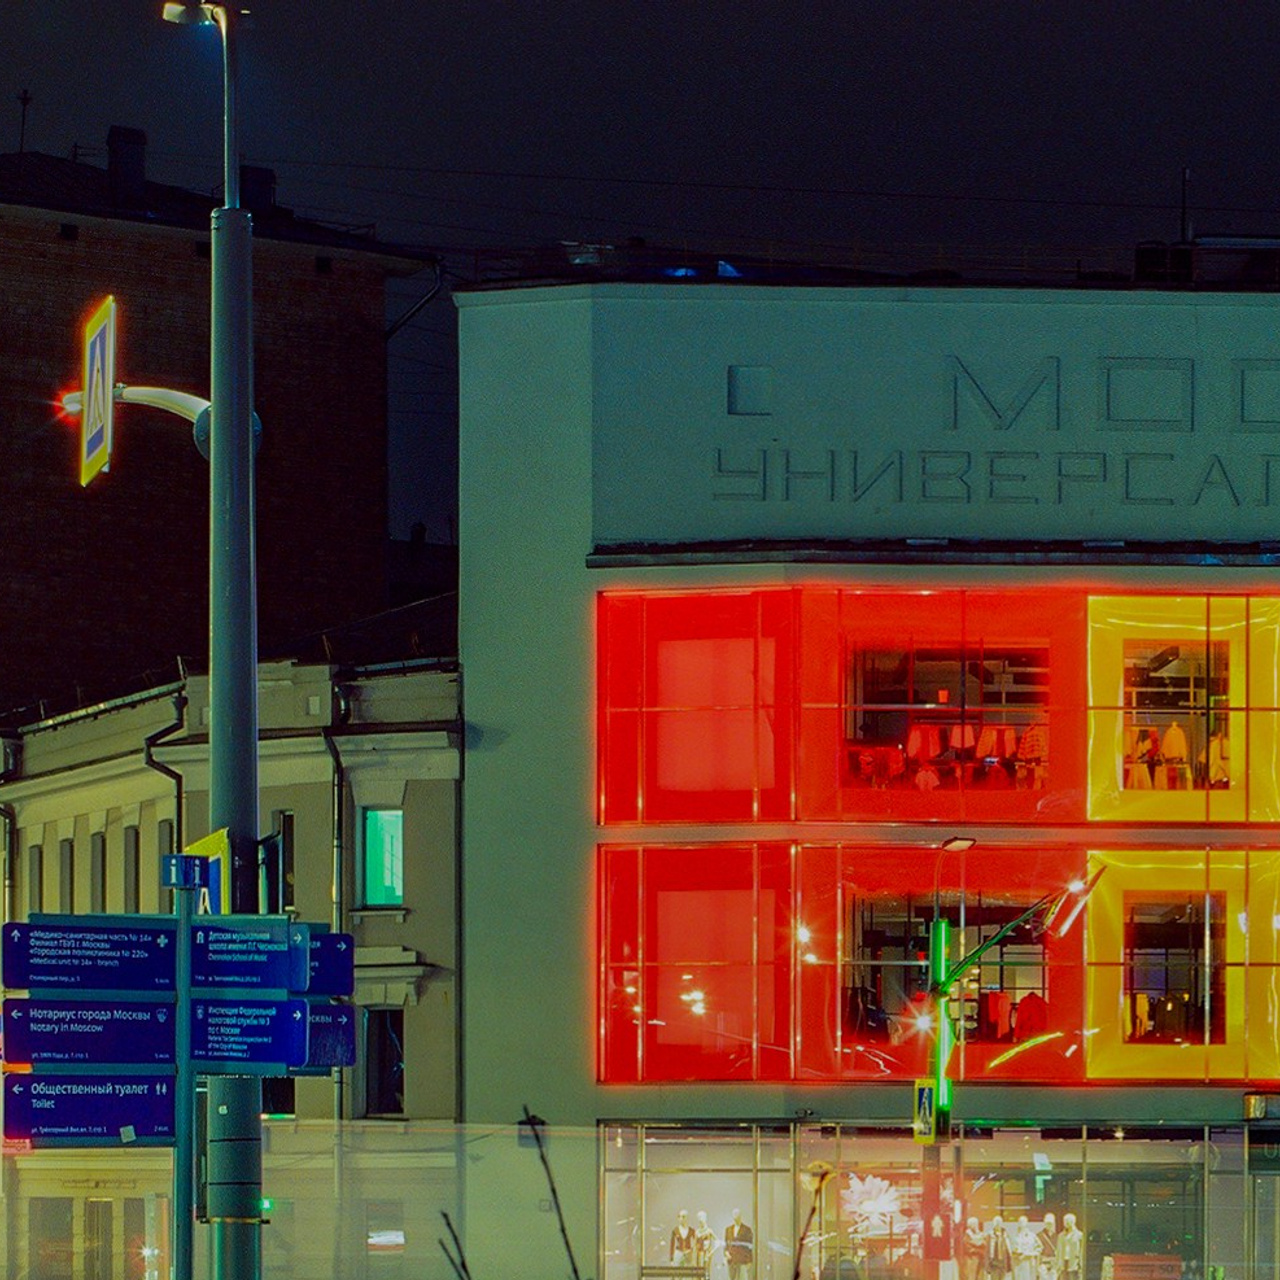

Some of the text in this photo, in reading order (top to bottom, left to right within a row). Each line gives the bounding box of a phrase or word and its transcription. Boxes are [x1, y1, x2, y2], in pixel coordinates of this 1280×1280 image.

[29, 1008, 151, 1022] Нотариус города Москвы
[30, 1022, 104, 1035] Notary in Moscow
[31, 1082, 149, 1097] Общественный туалет
[31, 1098, 55, 1109] Toilet
